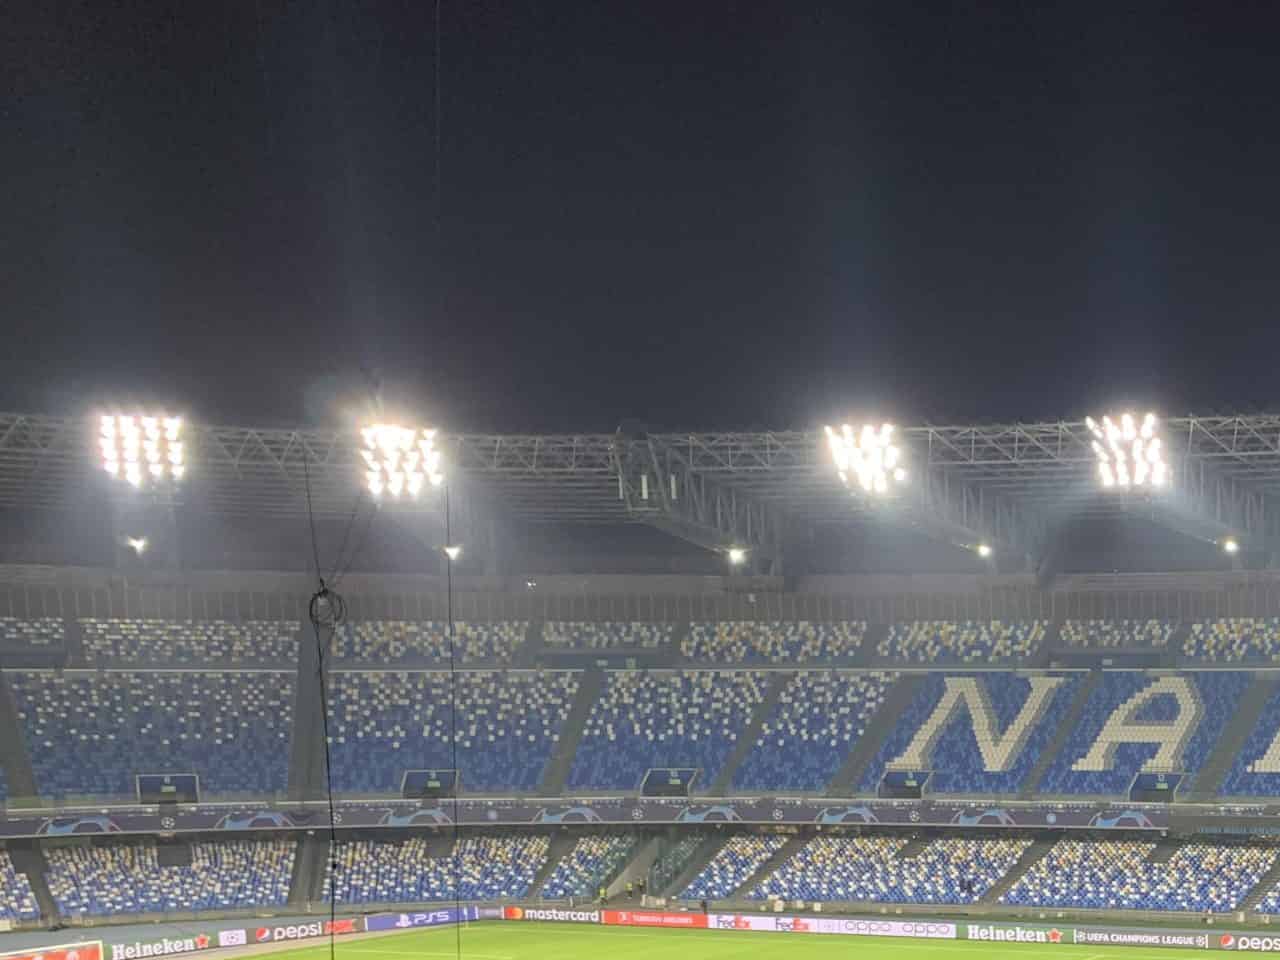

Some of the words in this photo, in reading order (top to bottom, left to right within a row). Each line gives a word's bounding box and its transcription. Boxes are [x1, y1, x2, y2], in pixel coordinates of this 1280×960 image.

[414, 911, 449, 925] PS5
[525, 909, 599, 922] mastercard
[273, 921, 322, 940] pepsi
[967, 925, 1046, 942] Heineken
[1087, 932, 1110, 942] UEFA
[1111, 933, 1160, 944] CHAMPIONS
[1162, 935, 1194, 945] LEAGUE
[111, 938, 195, 960] Heineken
